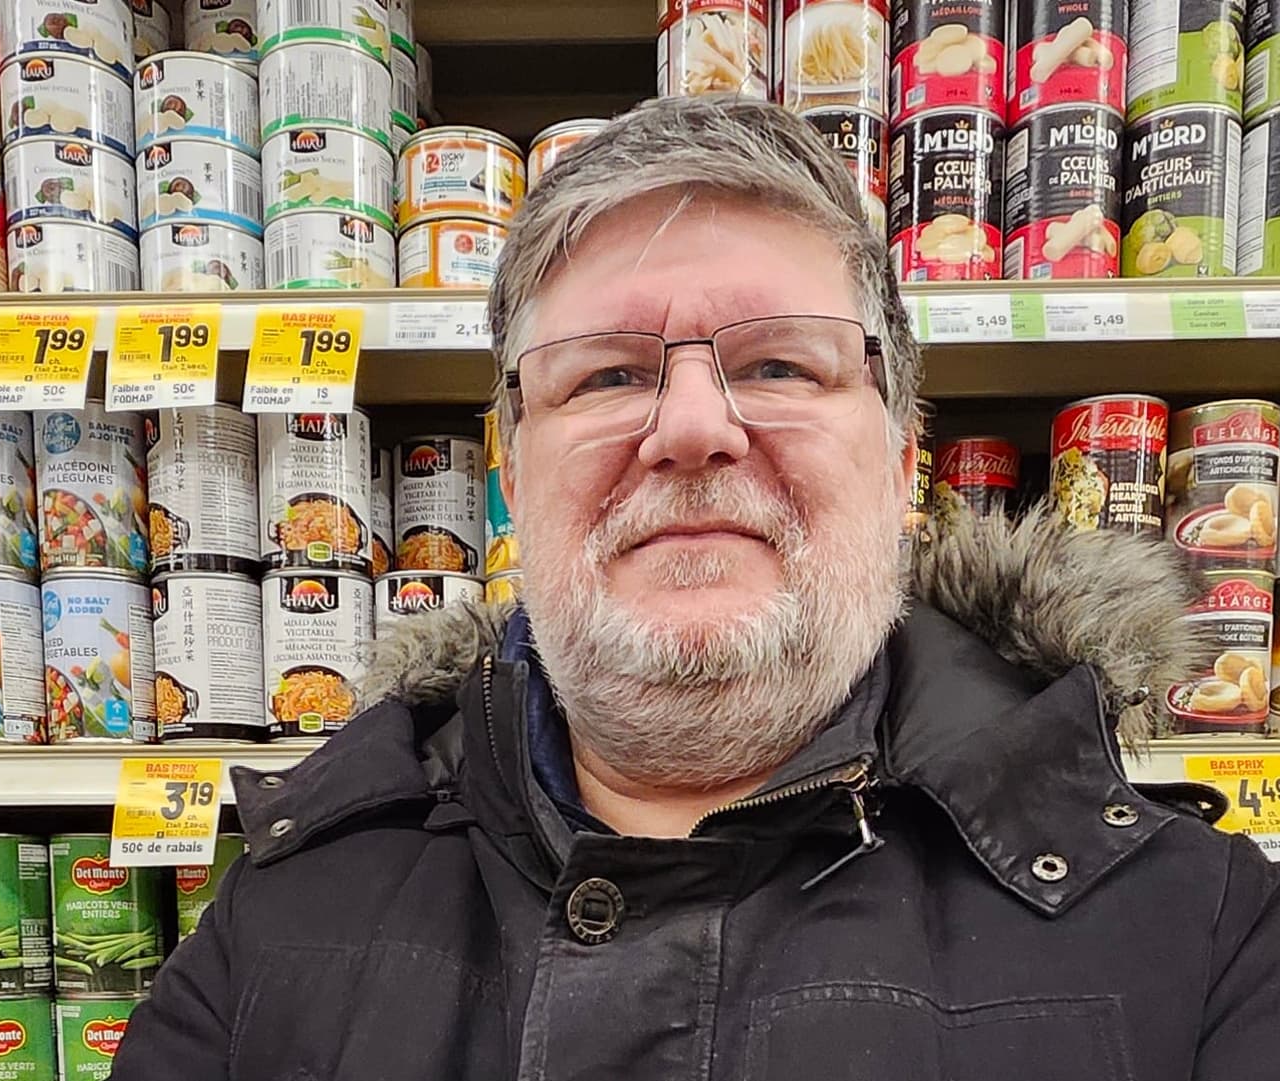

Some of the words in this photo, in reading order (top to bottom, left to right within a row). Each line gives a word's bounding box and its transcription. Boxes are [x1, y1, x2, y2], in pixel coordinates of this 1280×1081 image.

[1049, 125, 1117, 150] M'LORD
[1132, 124, 1206, 161] M'LORD
[1125, 169, 1214, 204] D'ARTICHAUT
[310, 314, 336, 323] PRIX
[977, 315, 1006, 327] 5,49
[14, 385, 26, 393] en
[282, 587, 336, 608] HAIKU
[146, 763, 168, 773] BAS
[172, 764, 198, 774] PRIX
[121, 842, 144, 853] 50¢
[148, 844, 162, 852] de
[166, 842, 203, 852] rabais
[8, 1062, 35, 1071] VERTS
